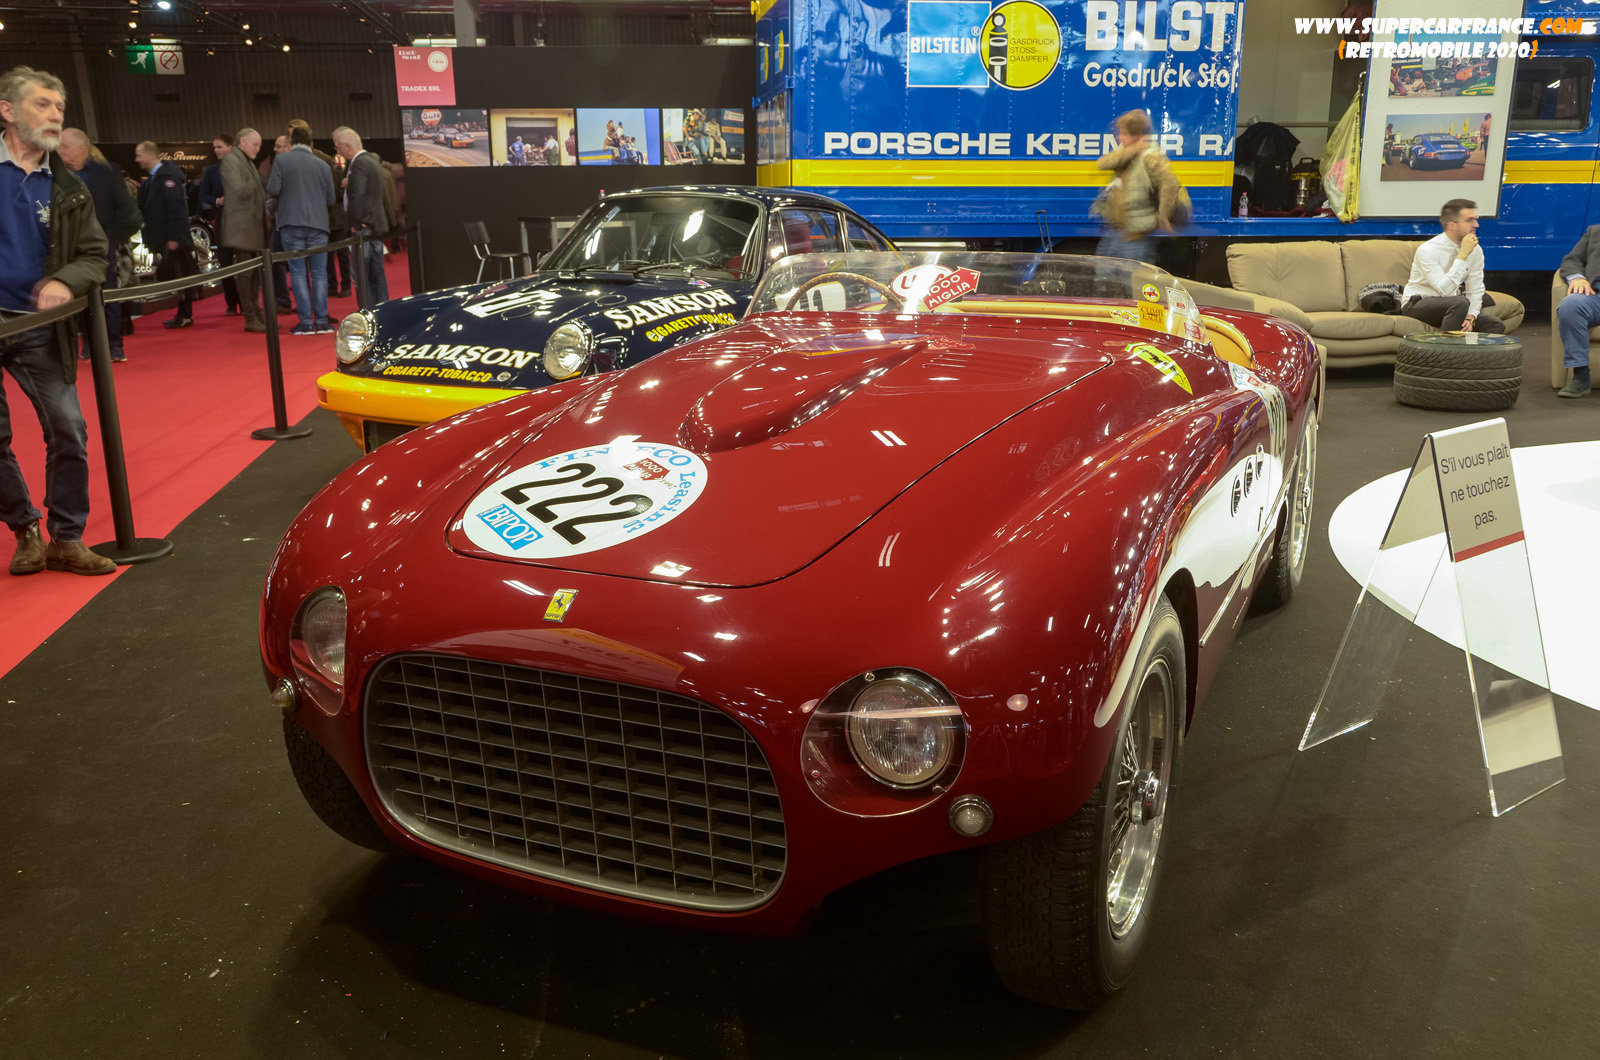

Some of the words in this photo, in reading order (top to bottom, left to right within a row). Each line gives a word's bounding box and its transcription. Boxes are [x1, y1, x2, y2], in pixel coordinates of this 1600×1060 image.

[1085, 0, 1244, 52] BILST
[910, 37, 977, 54] BILSTEIN
[1009, 46, 1039, 54] STOSS-
[1083, 62, 1192, 88] Gasdruck
[173, 150, 207, 161] Romeo
[823, 132, 1011, 156] PORSCHE
[928, 281, 971, 308] MIGLIA
[603, 288, 737, 330] SAMSON
[1142, 313, 1164, 324] EAGLE
[385, 343, 541, 369] SAMSON
[382, 365, 493, 383] CIGARETT-TOBACCO
[640, 459, 663, 473] 1000
[1440, 456, 1457, 475] S'il
[1457, 452, 1485, 470] vous
[1486, 442, 1509, 466] plaît
[1450, 487, 1465, 503] ne
[1466, 475, 1510, 499] touchez
[500, 462, 654, 546] 222
[623, 471, 696, 534] Leasing
[482, 507, 539, 544] BIPOP
[1474, 509, 1498, 530] pas.
